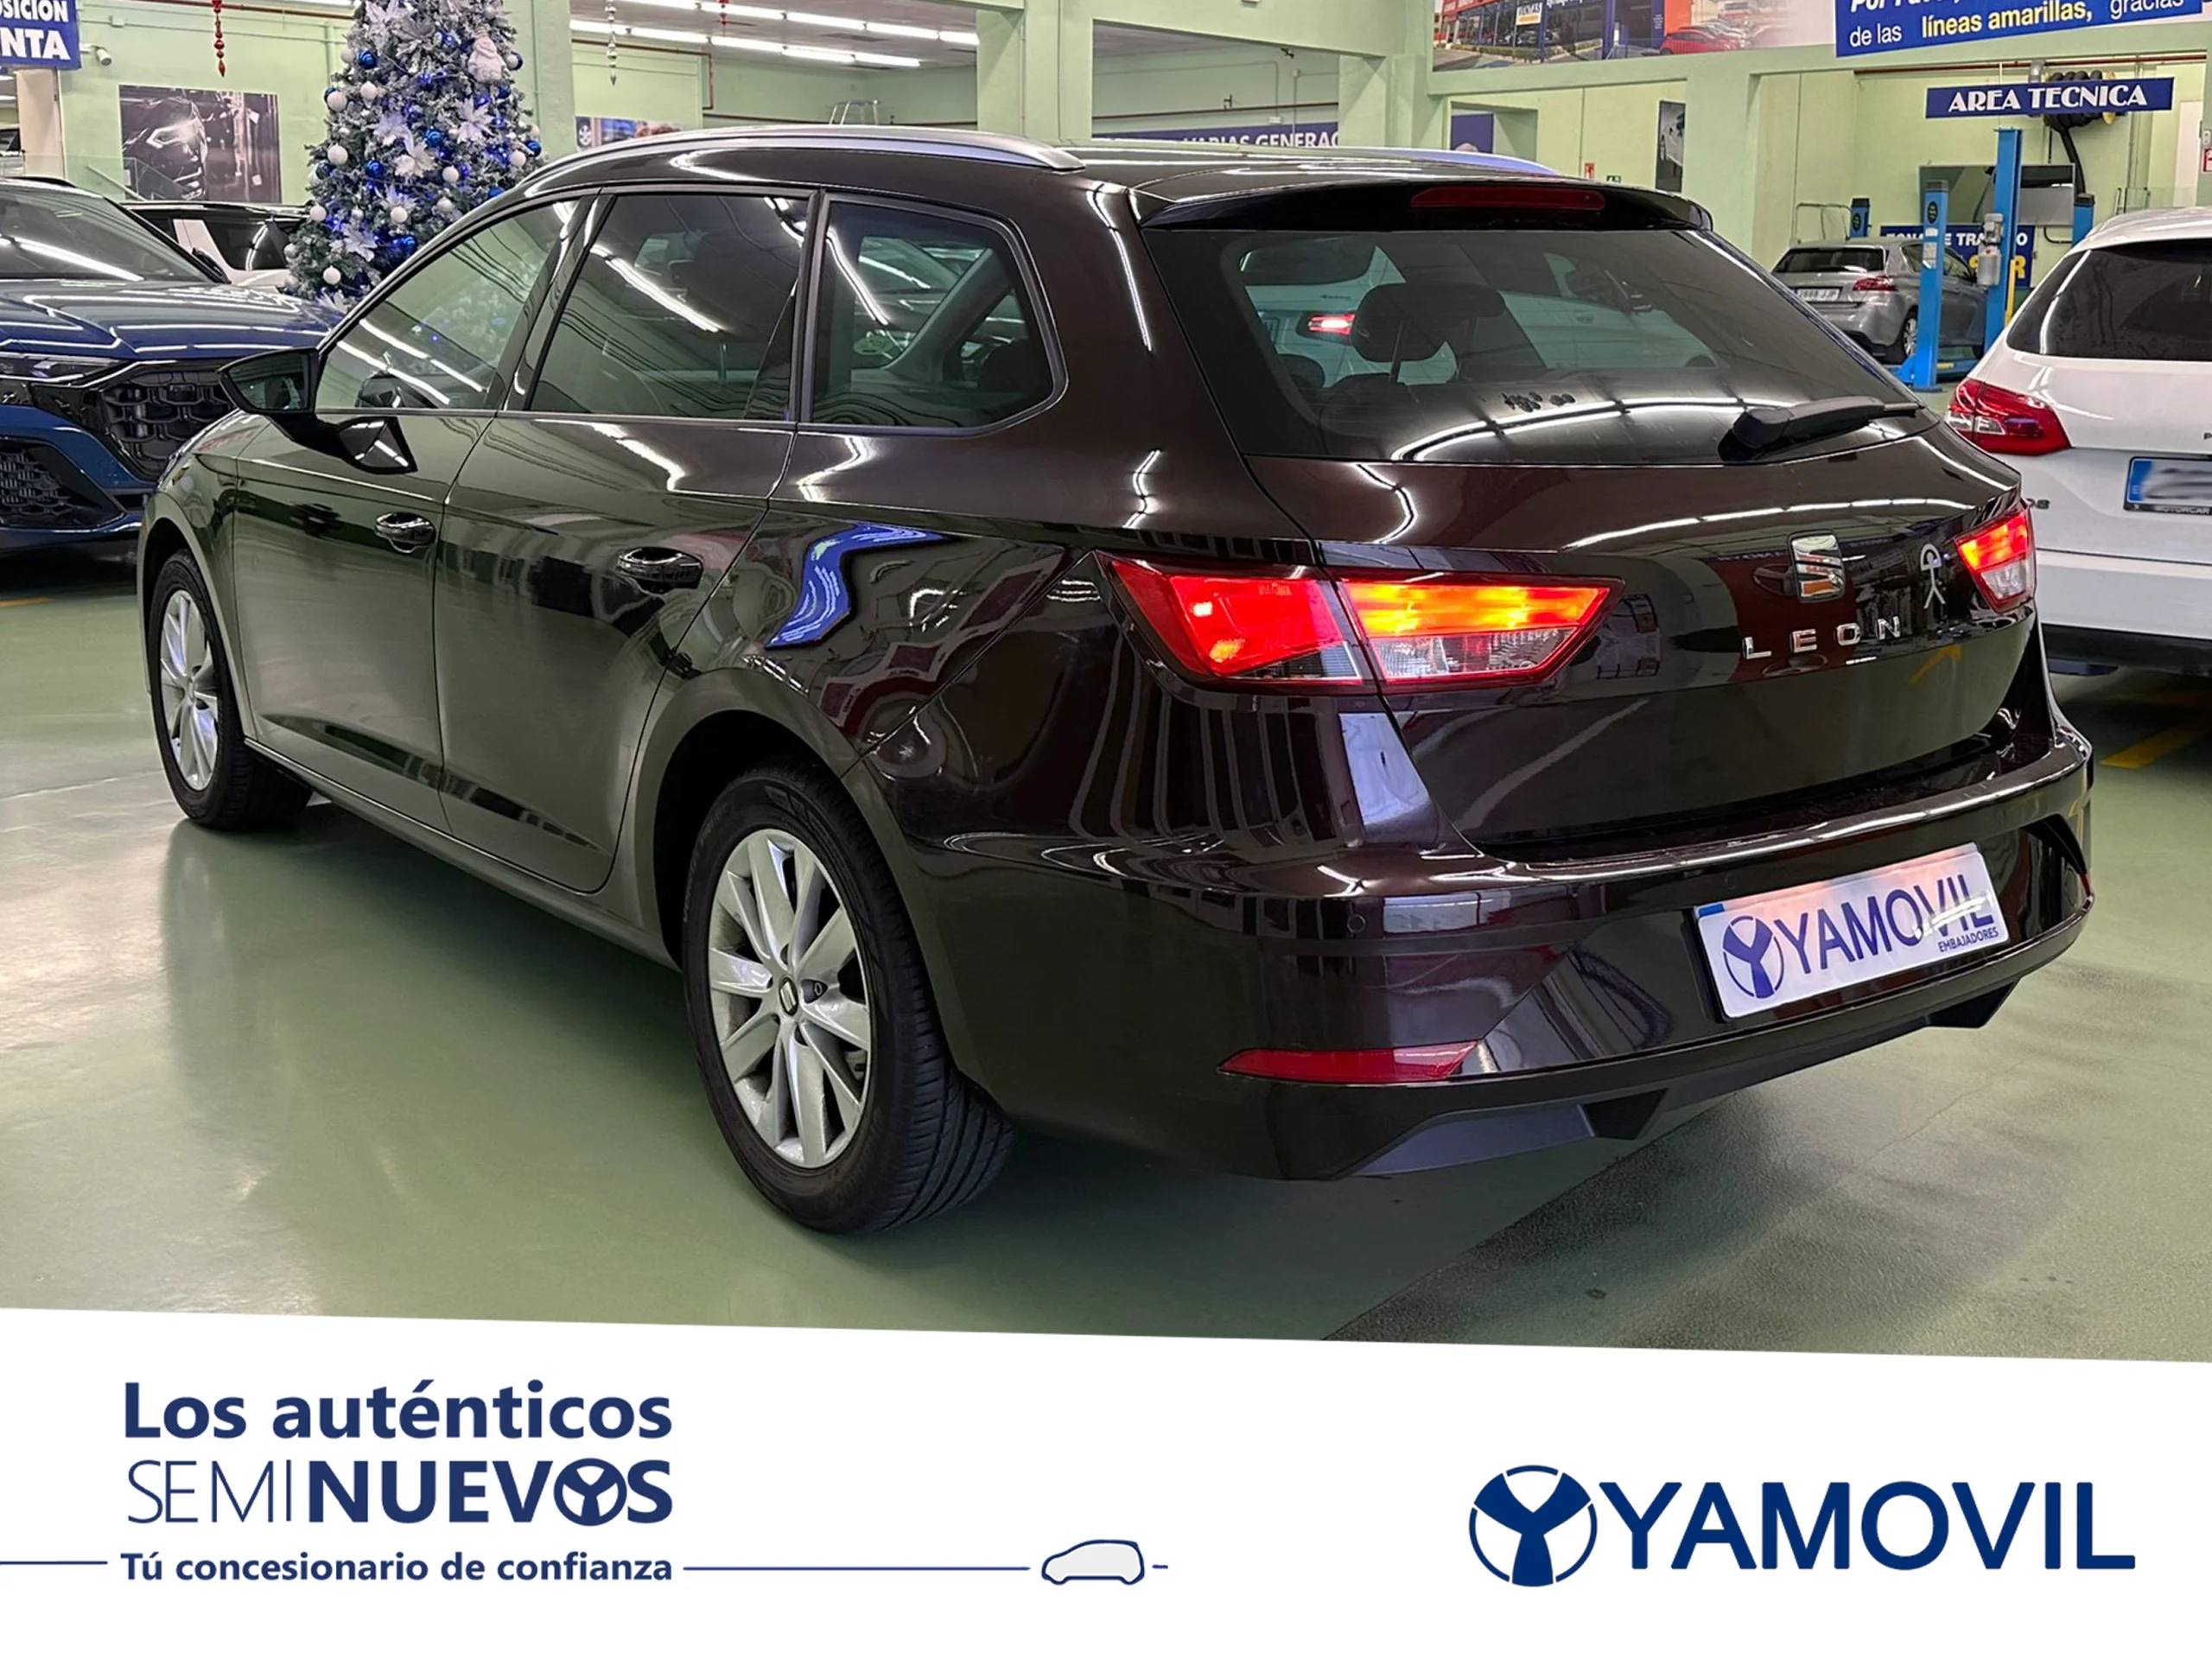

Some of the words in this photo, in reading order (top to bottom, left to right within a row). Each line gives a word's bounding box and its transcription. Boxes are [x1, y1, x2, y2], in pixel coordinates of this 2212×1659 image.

[0, 0, 68, 22] SICION
[1849, 26, 1872, 47] de
[1877, 23, 1902, 44] las
[1922, 15, 1982, 38] líneas
[1988, 0, 2093, 30] amarillas,
[0, 27, 71, 60] NTA
[1948, 90, 2021, 112] AREA
[2028, 85, 2147, 109] TECNICA
[1742, 615, 1901, 660] LEON
[1774, 874, 1994, 974] YAMOVIL
[1938, 926, 1999, 953] EMBAJADORES
